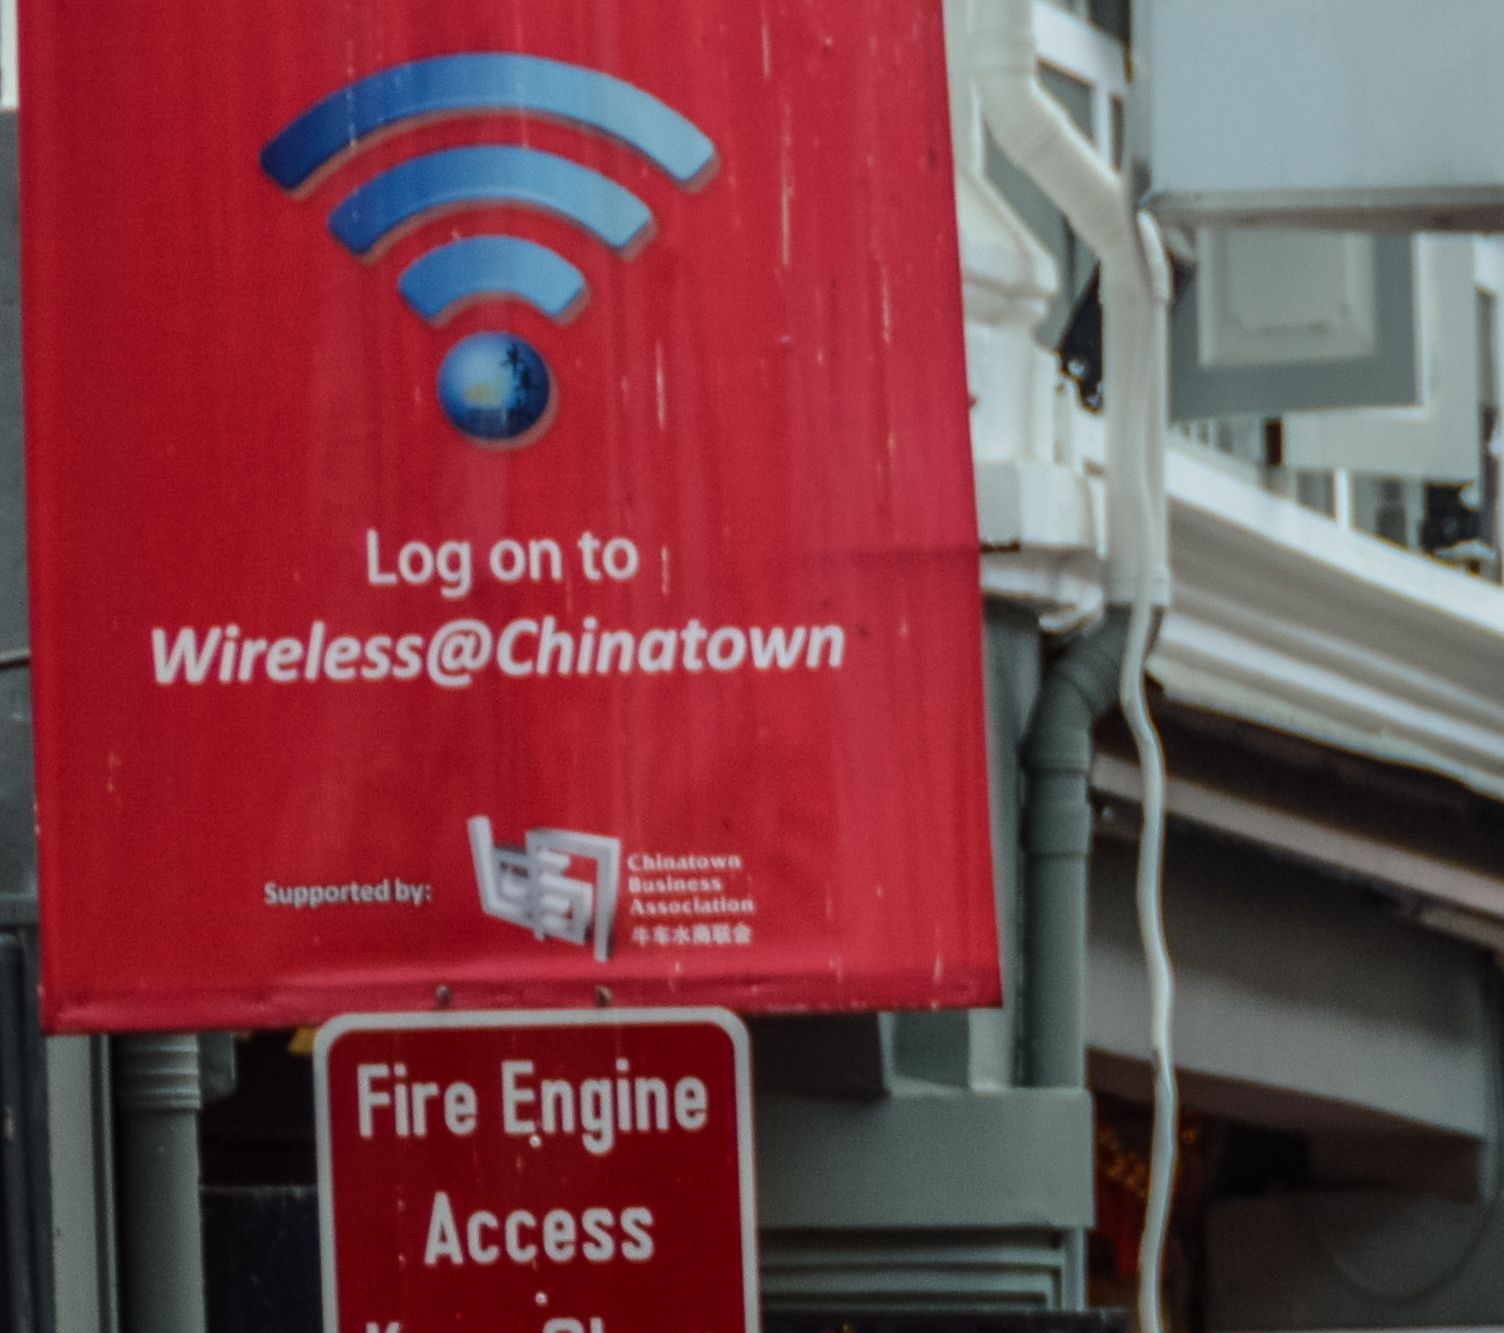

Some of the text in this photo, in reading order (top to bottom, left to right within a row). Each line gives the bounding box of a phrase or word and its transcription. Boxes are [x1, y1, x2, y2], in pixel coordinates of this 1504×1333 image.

[366, 529, 640, 598] Log on to
[150, 615, 846, 688] Wireless@Chinatown
[627, 852, 742, 872] Chinatown
[628, 877, 723, 895] Business
[263, 880, 432, 908] Supported by:
[630, 897, 755, 916] Association
[356, 1057, 708, 1155] Fire Engine
[423, 1190, 655, 1265] Access
